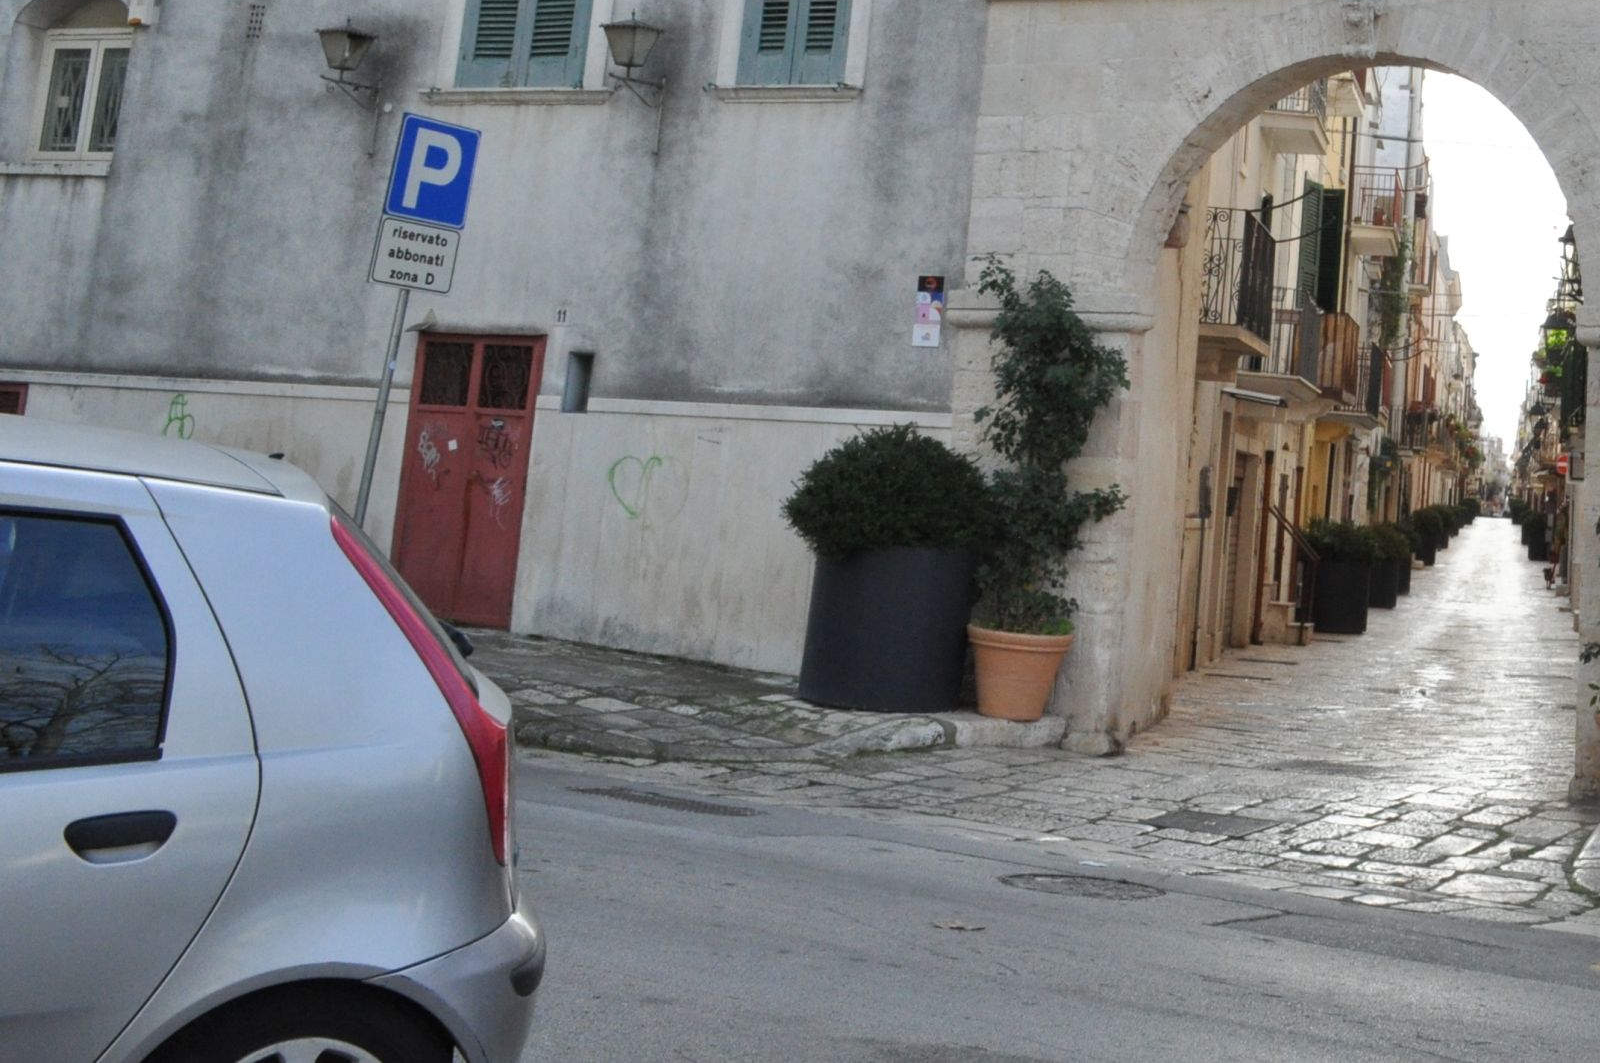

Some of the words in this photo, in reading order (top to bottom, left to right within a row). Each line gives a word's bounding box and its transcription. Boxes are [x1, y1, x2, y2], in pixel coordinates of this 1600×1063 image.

[402, 127, 463, 209] P
[392, 226, 448, 247] riservato
[388, 246, 445, 267] abbonati
[389, 269, 418, 283] zona
[425, 272, 435, 285] D
[557, 308, 567, 323] 11
